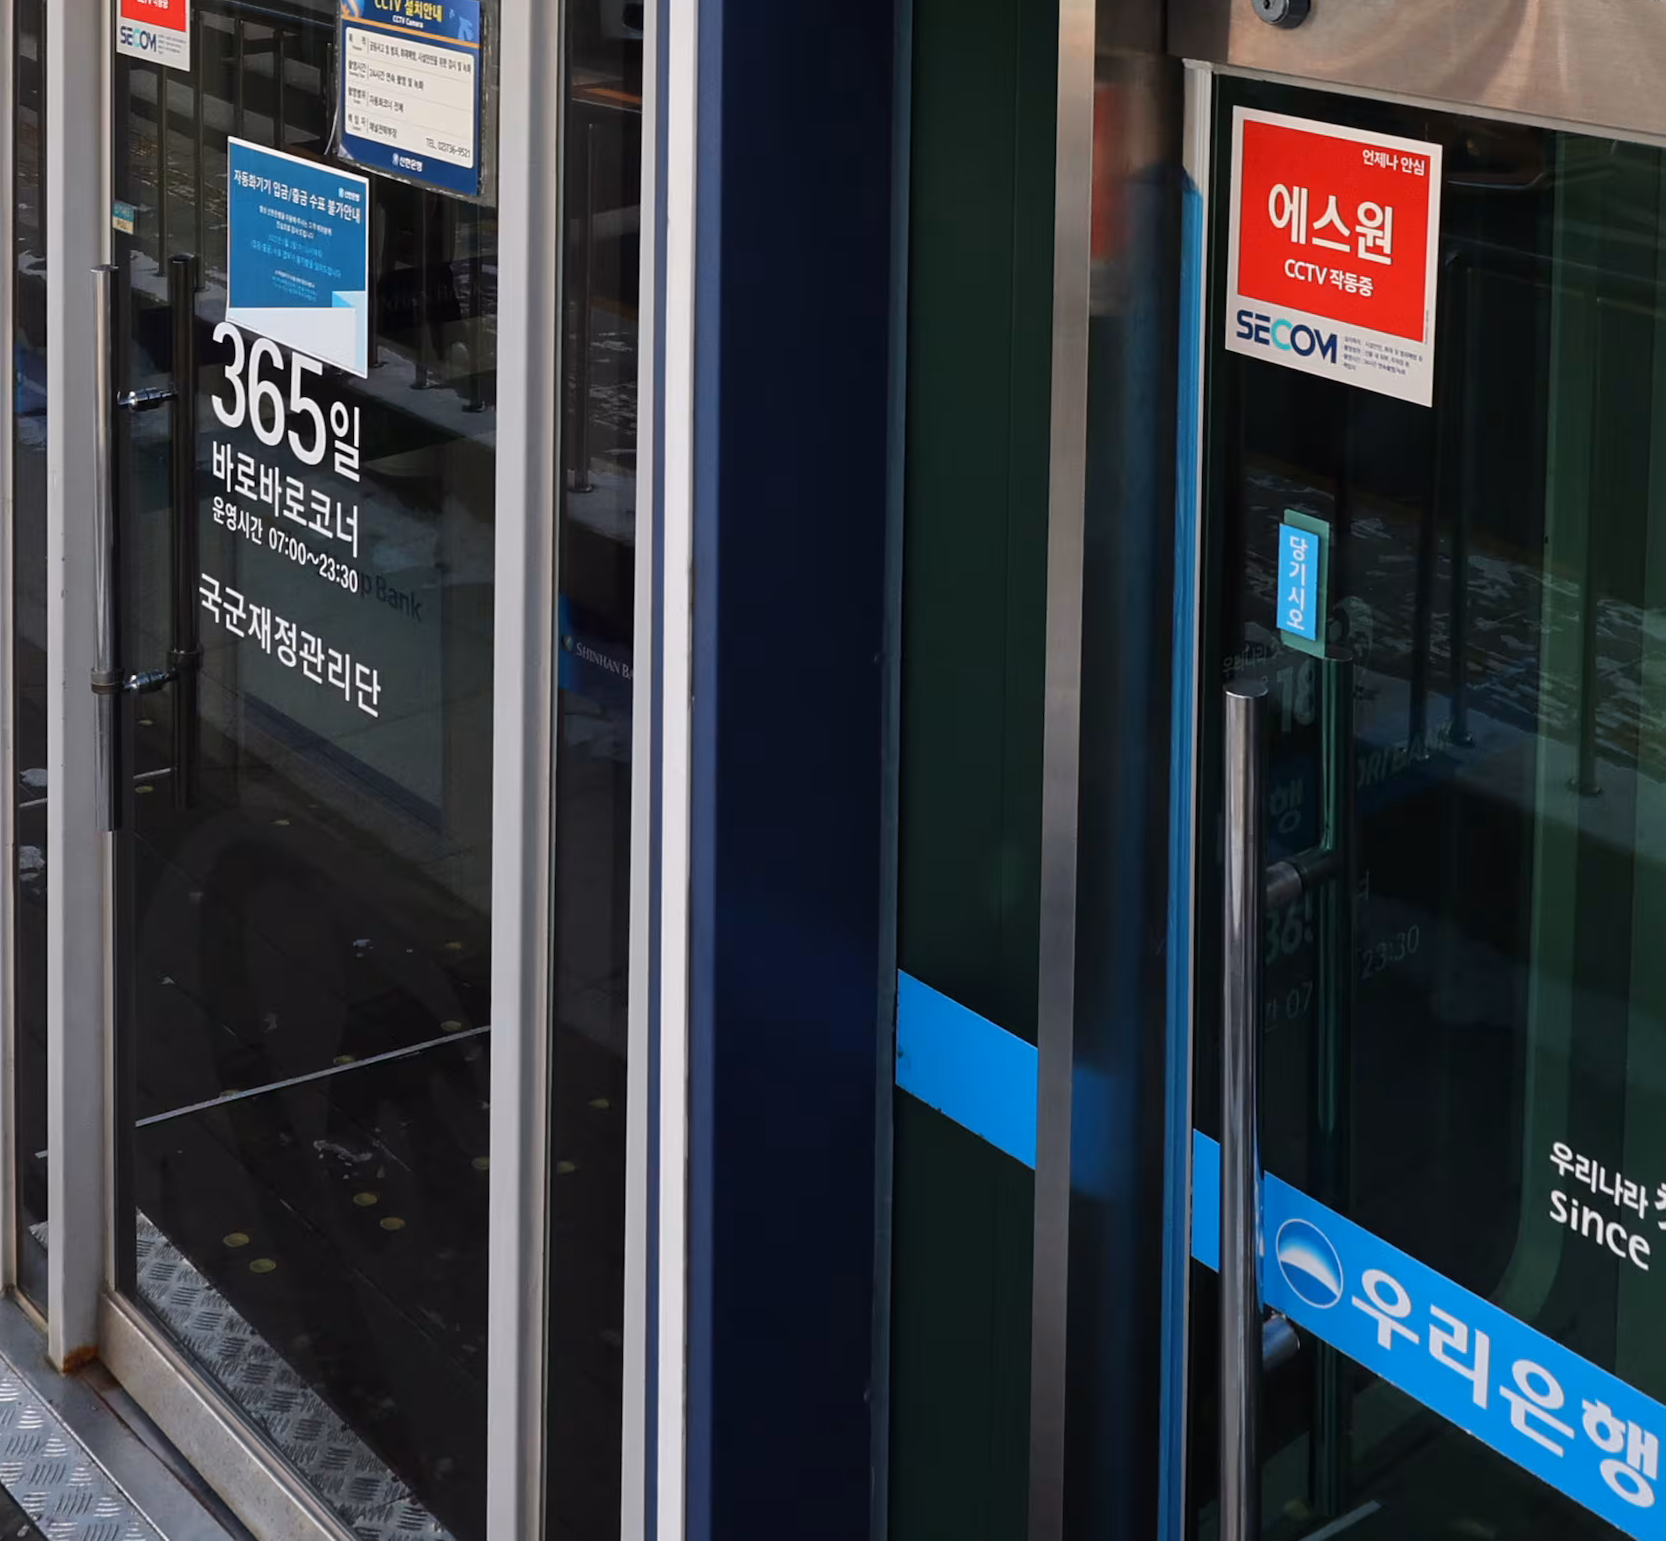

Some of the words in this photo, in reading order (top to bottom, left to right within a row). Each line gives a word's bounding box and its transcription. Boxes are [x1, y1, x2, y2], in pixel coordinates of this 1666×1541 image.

[120, 25, 158, 54] SECOM
[233, 169, 272, 195] 자동화기기
[273, 181, 308, 207] 입금/출금
[309, 193, 326, 212] 수표
[327, 199, 361, 224] 불가안내
[1362, 149, 1398, 171] 언제나
[1400, 157, 1425, 176] 안심
[1268, 184, 1393, 265] 에스원
[1284, 259, 1327, 285] CCTV
[1329, 268, 1374, 297] 작동중
[1236, 309, 1338, 365] SECOM
[212, 440, 359, 559] 바로바로코너
[212, 495, 263, 545] 운영시간
[268, 526, 359, 594] 07:00~23:30
[1286, 534, 1308, 631] 당기시오
[199, 572, 382, 717] 국군재정관리단
[1549, 1141, 1649, 1219] 우리나라
[1351, 1268, 1659, 1508] 우리은행
